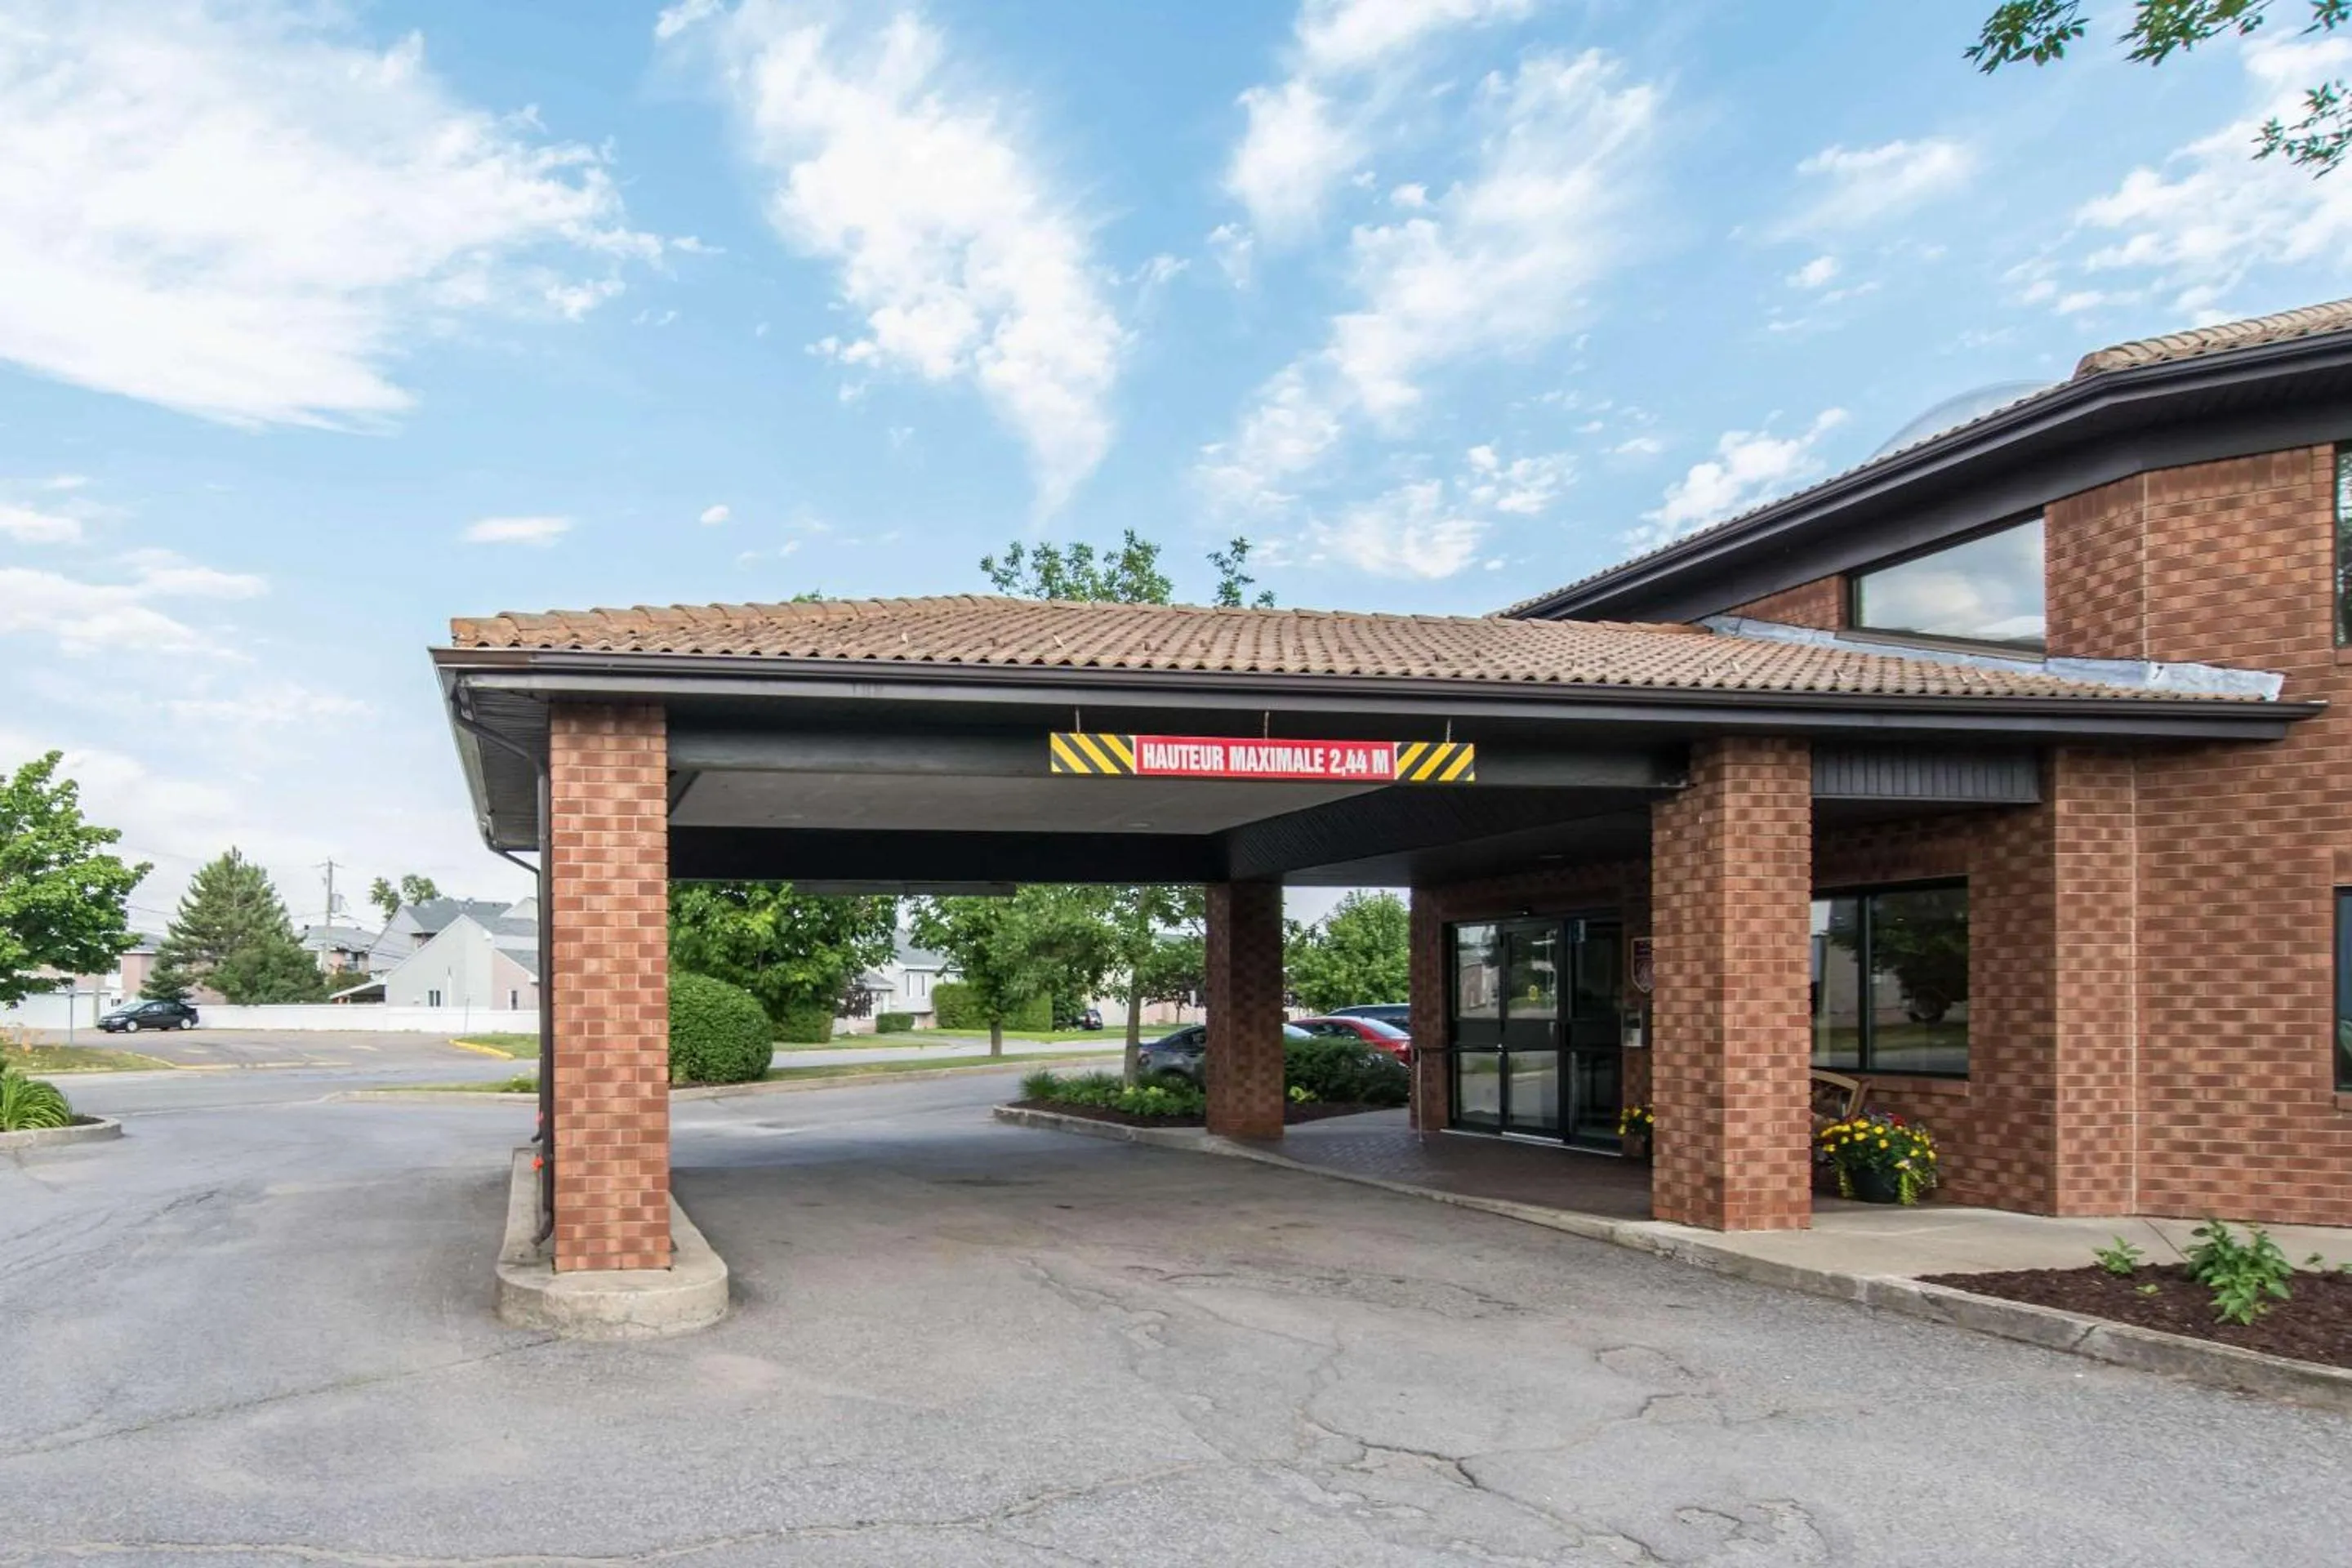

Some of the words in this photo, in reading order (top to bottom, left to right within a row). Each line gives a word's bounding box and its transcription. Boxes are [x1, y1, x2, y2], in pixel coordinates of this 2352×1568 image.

[1143, 743, 1225, 772] HAUTEUR
[1229, 746, 1325, 773] MAXIMALE
[1330, 748, 1368, 777] 2,44
[1372, 749, 1390, 774] M
